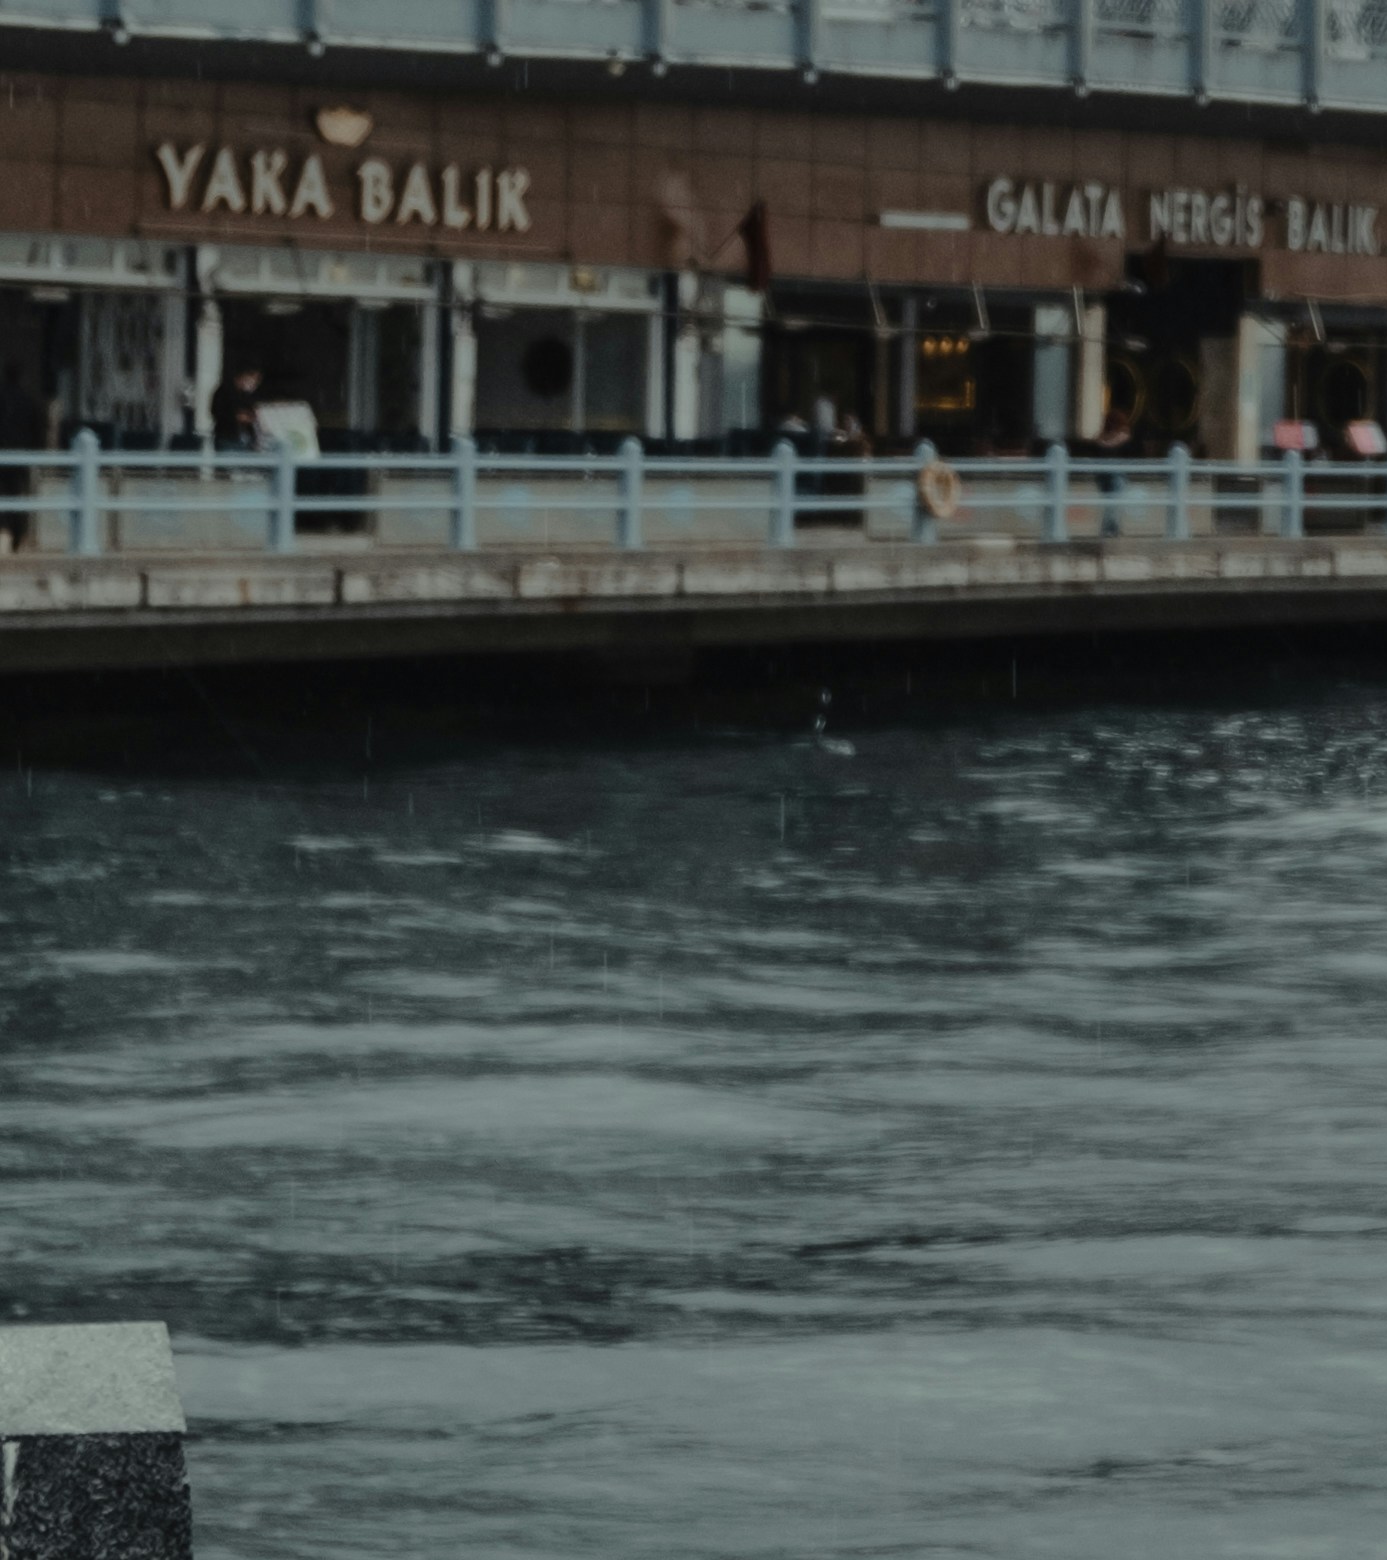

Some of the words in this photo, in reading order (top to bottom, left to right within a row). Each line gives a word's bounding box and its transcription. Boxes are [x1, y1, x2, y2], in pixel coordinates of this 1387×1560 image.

[157, 143, 335, 220] YAKA
[357, 158, 531, 233] BALIK
[986, 177, 1125, 238] GALATA
[1286, 194, 1380, 255] BALIK
